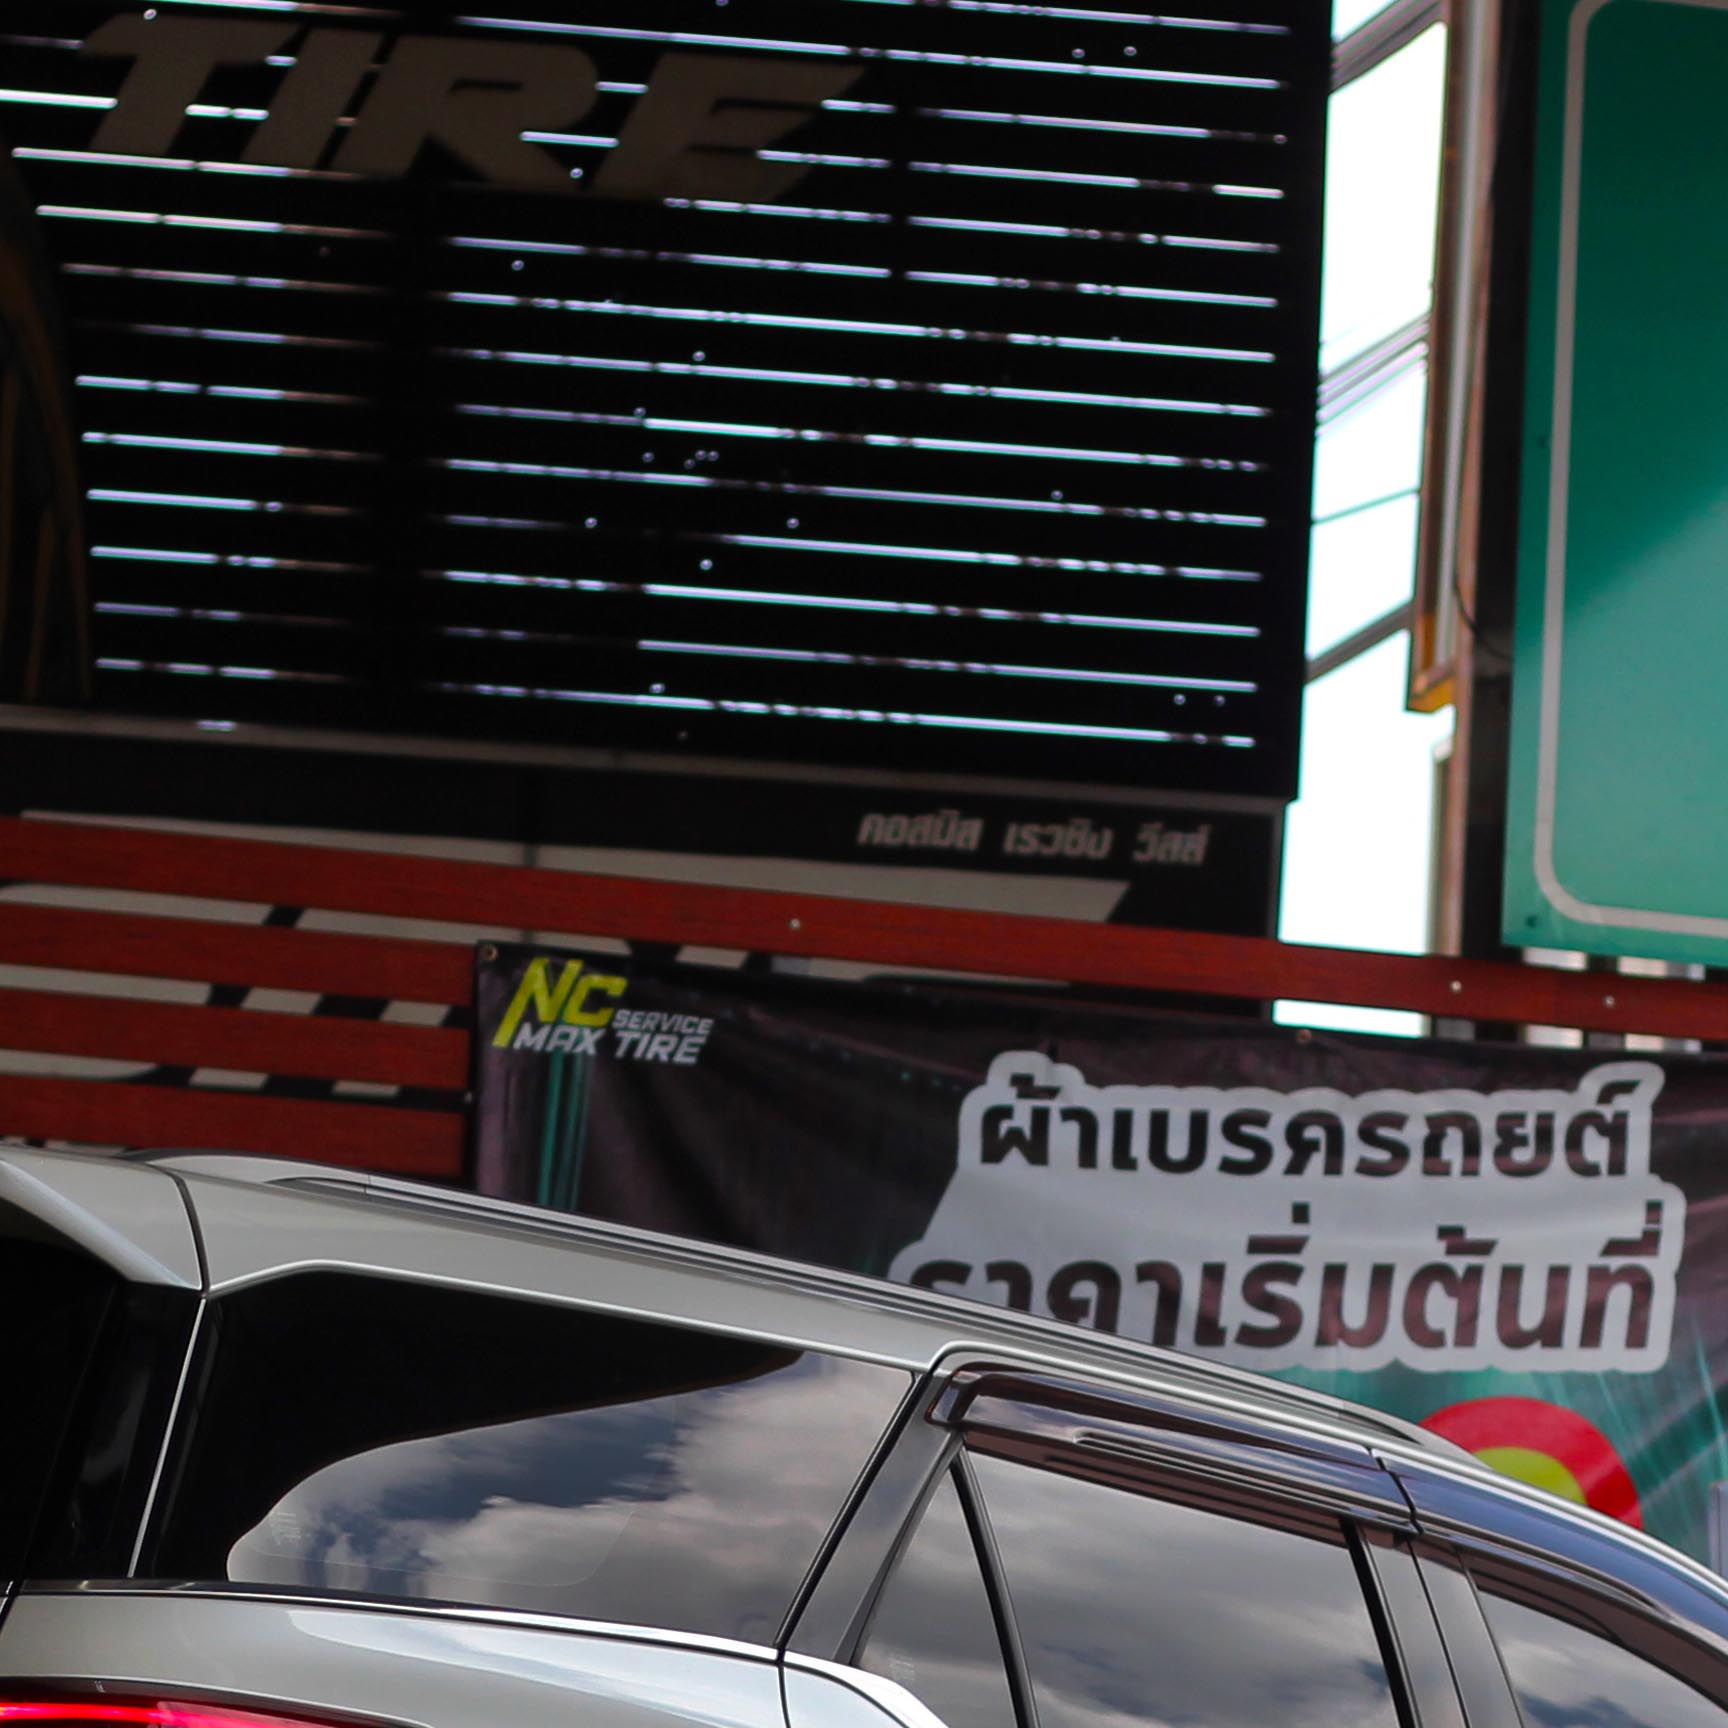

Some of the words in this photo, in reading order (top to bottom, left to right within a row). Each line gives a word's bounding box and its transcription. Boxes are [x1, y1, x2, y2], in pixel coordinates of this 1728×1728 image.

[75, 12, 869, 203] TIRE
[491, 957, 629, 1048] NC
[612, 1009, 714, 1035] SERVICE
[513, 1021, 606, 1056] MAX
[615, 1030, 707, 1065] TIRE
